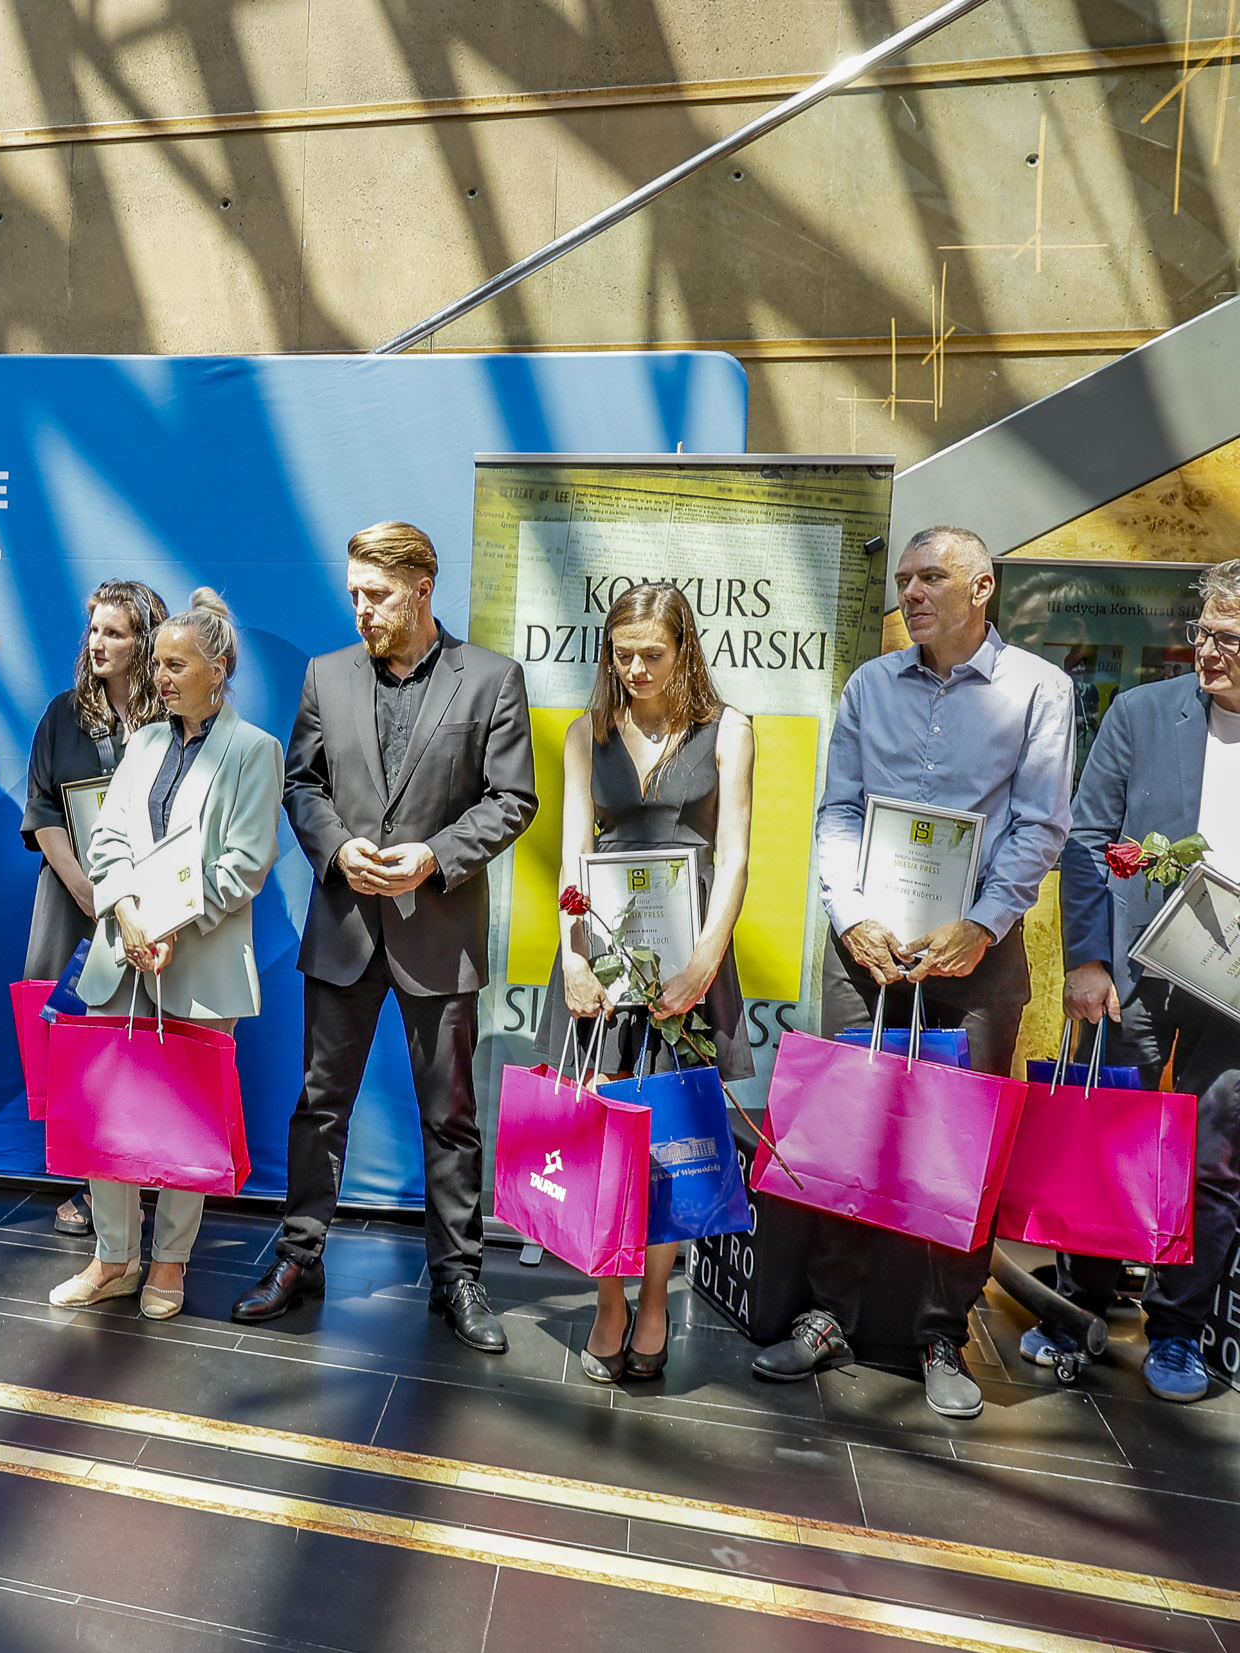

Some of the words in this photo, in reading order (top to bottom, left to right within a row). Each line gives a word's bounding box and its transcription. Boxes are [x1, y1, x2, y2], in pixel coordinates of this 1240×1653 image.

[583, 575, 772, 618] KOURS
[1065, 602, 1106, 616] edycja
[1111, 603, 1174, 616] Konkursu
[920, 864, 941, 875] PRESS
[653, 937, 669, 945] Loch
[530, 1171, 567, 1202] TAURON
[689, 1244, 750, 1325] POLIA
